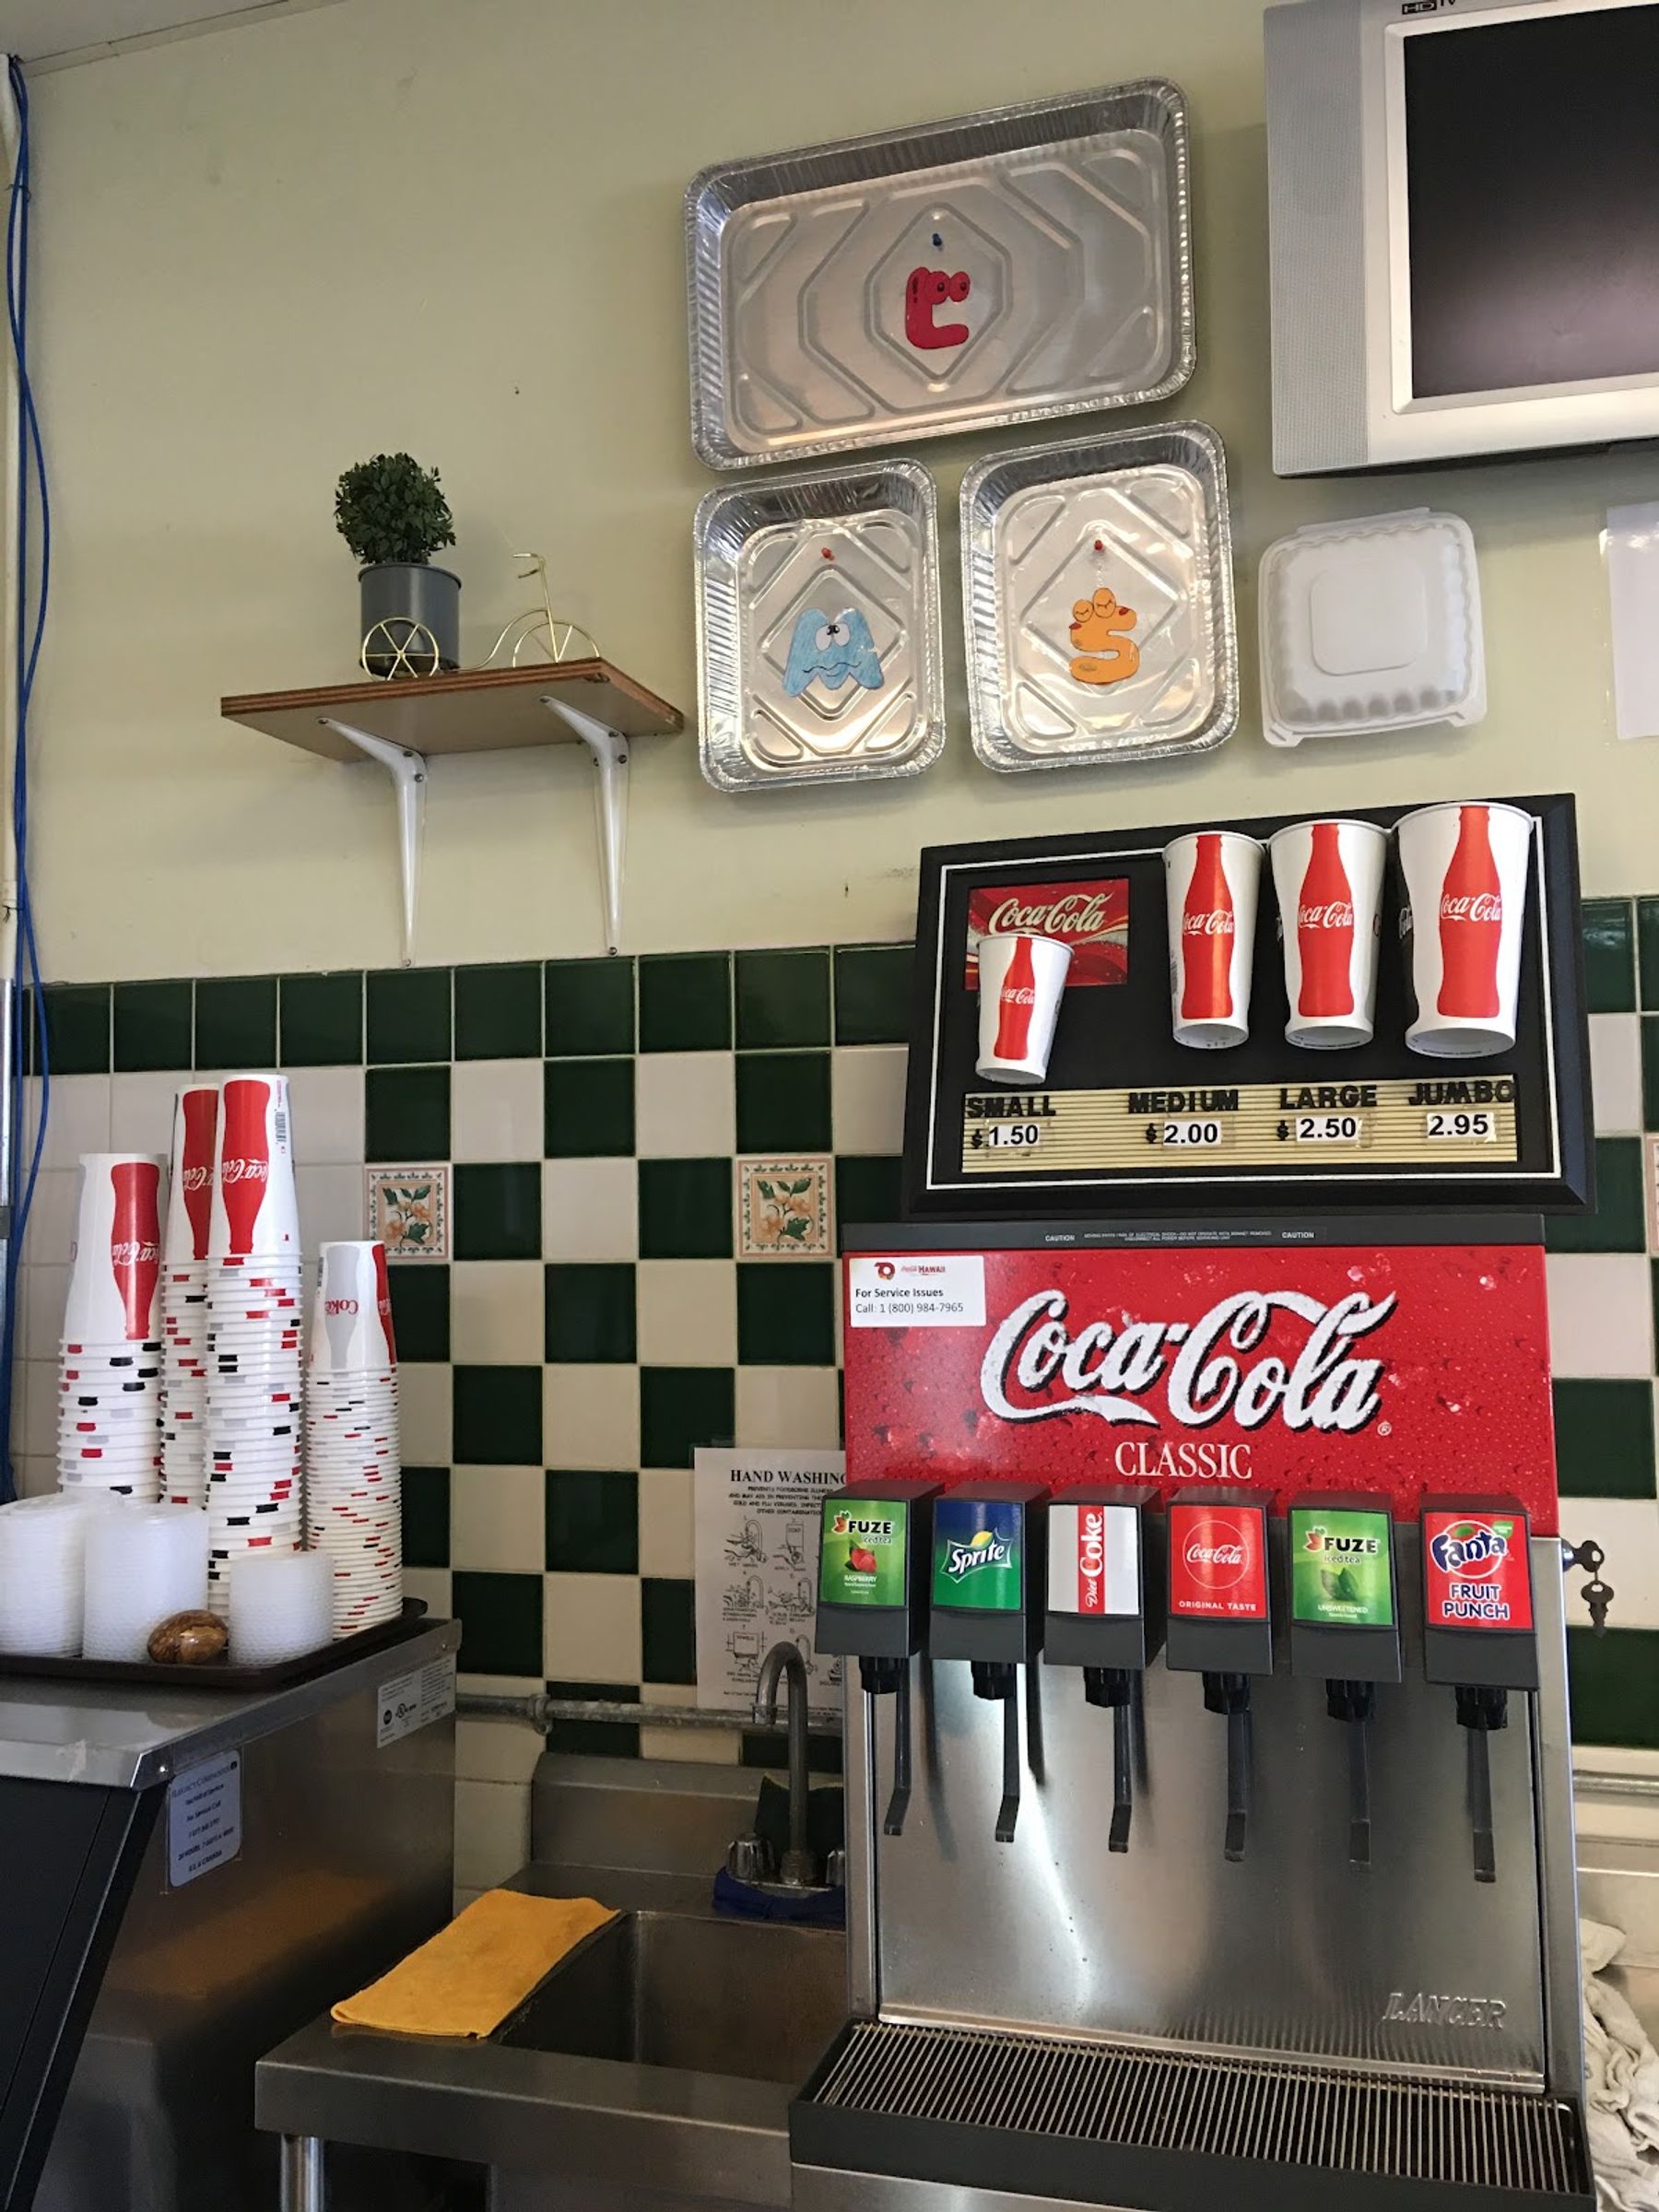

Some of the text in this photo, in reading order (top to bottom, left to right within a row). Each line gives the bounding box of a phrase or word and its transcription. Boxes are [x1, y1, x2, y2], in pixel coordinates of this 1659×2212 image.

[989, 891, 1116, 935] Coca-Cola
[1128, 1089, 1239, 1113] MEDIUM
[1280, 1085, 1377, 1110] LARGE
[1408, 1080, 1515, 1105] JUMBO
[968, 1095, 1056, 1118] SMALL
[1429, 1114, 1489, 1135] 2.95
[855, 1288, 944, 1298] For Service Issues
[855, 1304, 876, 1313] Call:
[888, 1303, 914, 1314] (800)
[916, 1302, 964, 1313] 984-7965
[981, 1289, 1397, 1430] Coca-Cola
[1114, 1441, 1253, 1479] CLASSIC
[730, 1469, 773, 1483] HAND
[849, 1521, 891, 1535] FUZE
[1187, 1544, 1244, 1564] Coca-Cola
[1324, 1537, 1377, 1553] FUZE
[1431, 1530, 1507, 1572] Fanta
[948, 1543, 1005, 1573] Sprite
[1080, 1512, 1102, 1608] Diet Coke
[1450, 1583, 1500, 1600] FRUIT
[1179, 1600, 1256, 1611] ORIGINAL TASTE
[1443, 1601, 1509, 1619] PUNCH
[1382, 1993, 1507, 2028] LANCER
